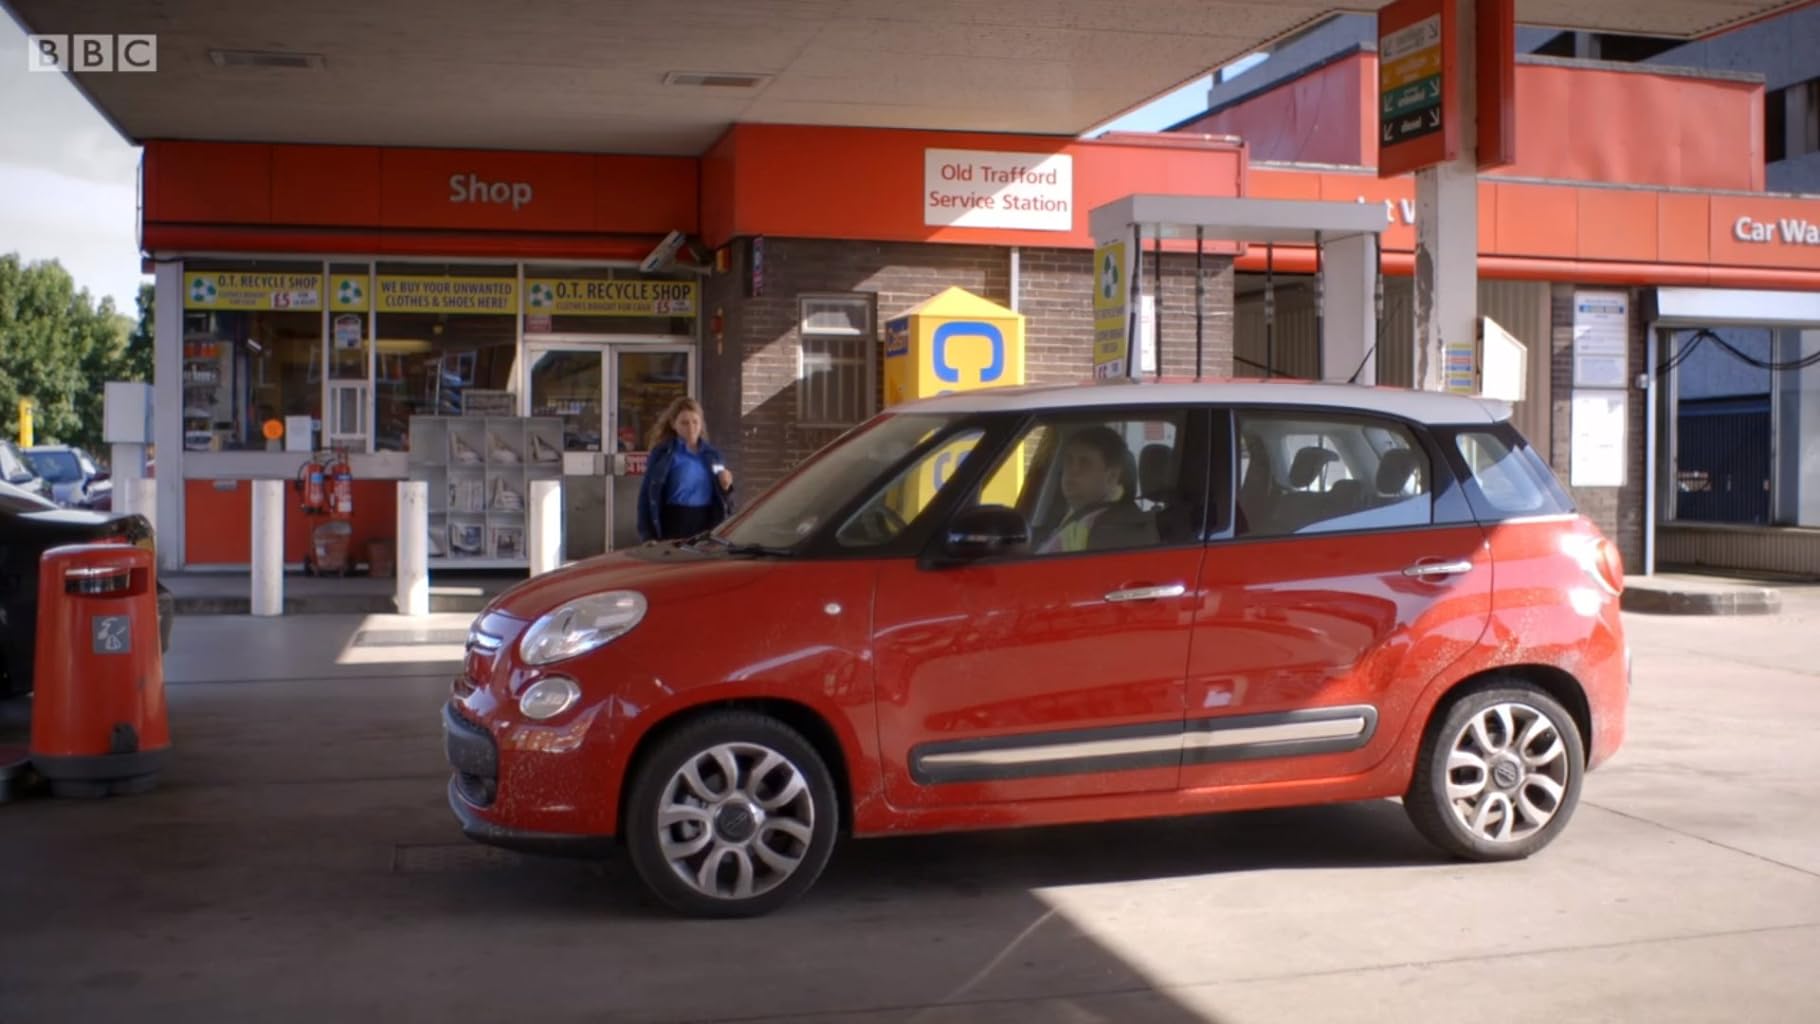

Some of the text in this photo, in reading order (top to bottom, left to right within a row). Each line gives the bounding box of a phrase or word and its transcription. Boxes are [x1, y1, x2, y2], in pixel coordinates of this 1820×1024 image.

[940, 163, 1057, 185] Old Trafford
[449, 173, 533, 211] Shop
[929, 190, 1068, 212] Service Station
[1735, 215, 1776, 241] Car
[218, 274, 318, 290] O.T. RECYCLE SHOP
[381, 280, 512, 296] WE BUY YOUR UNWANTED
[556, 282, 691, 301] O.T. RECYCLE SHOP
[385, 294, 508, 309] CLOTHES & SHOES HERE!
